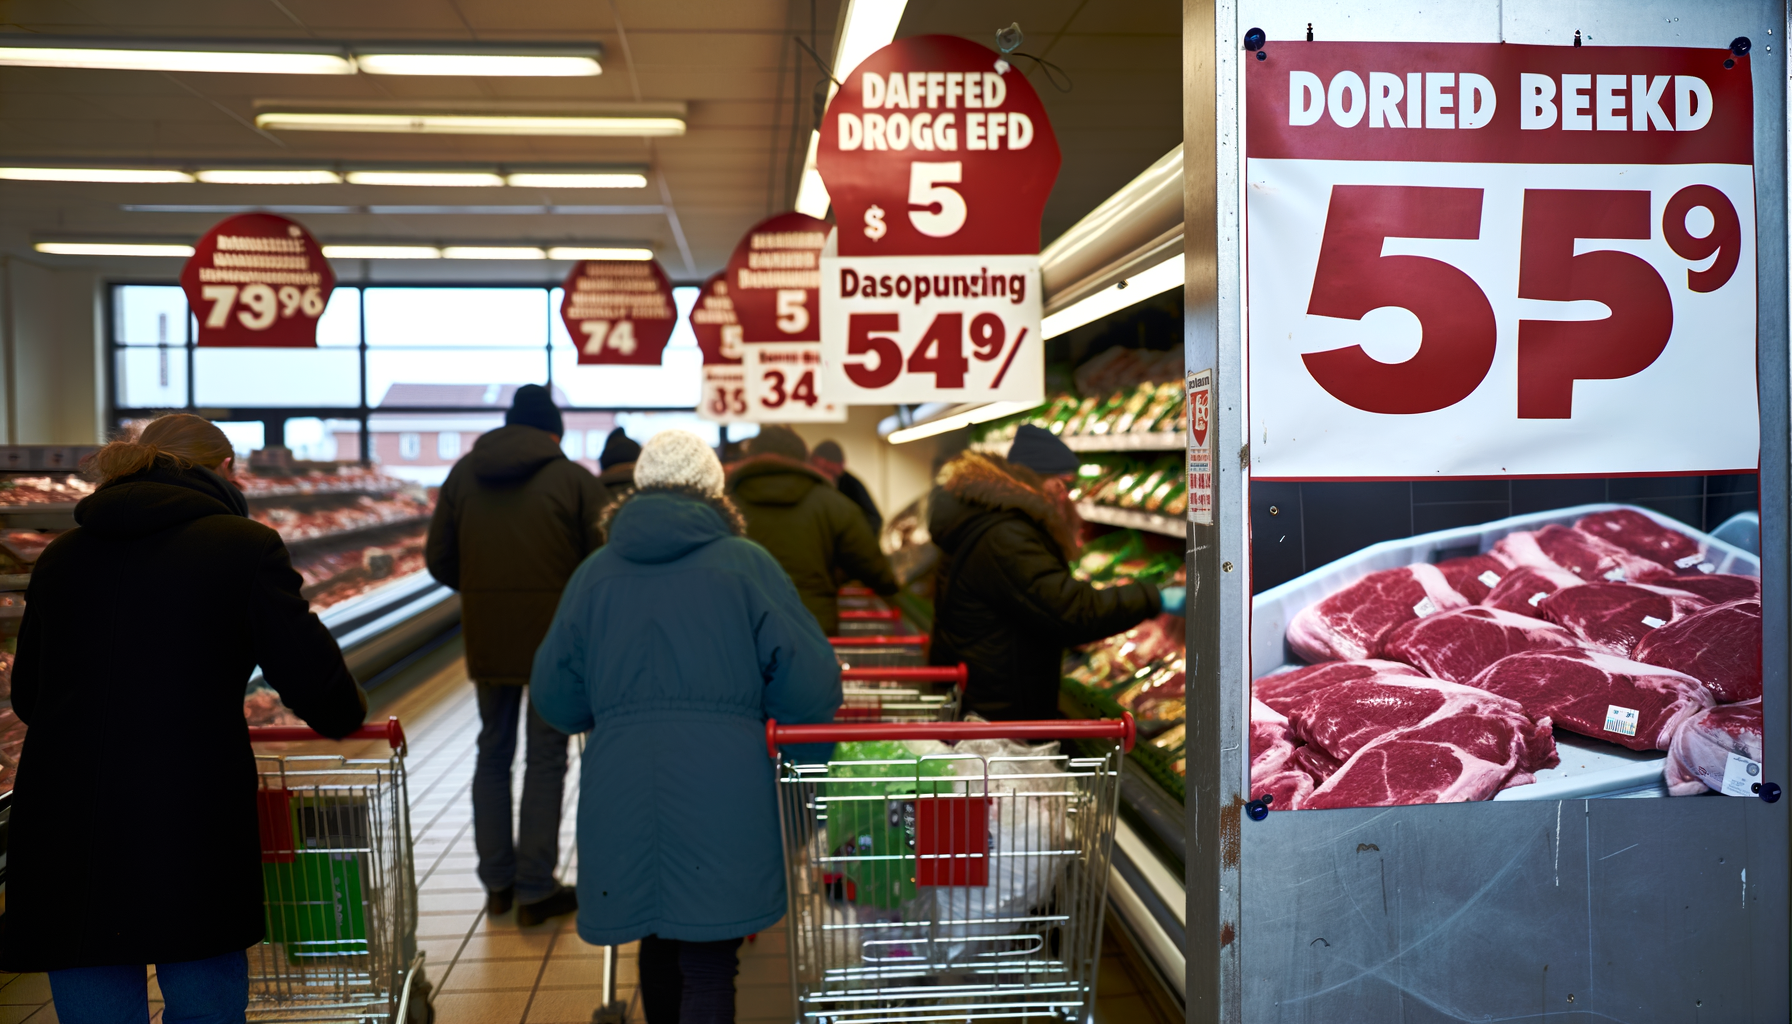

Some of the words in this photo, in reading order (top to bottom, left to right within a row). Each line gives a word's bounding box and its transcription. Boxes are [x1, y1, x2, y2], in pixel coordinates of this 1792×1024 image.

[862, 72, 1007, 110] DAFFFED
[1289, 71, 1497, 129] DORIED
[1520, 73, 1714, 132] BEEKD
[838, 112, 958, 151] DROGG
[966, 112, 1034, 151] EFD
[907, 161, 967, 238] 5
[776, 289, 810, 334] 5
[580, 320, 637, 356] 74
[761, 370, 818, 409] 34
